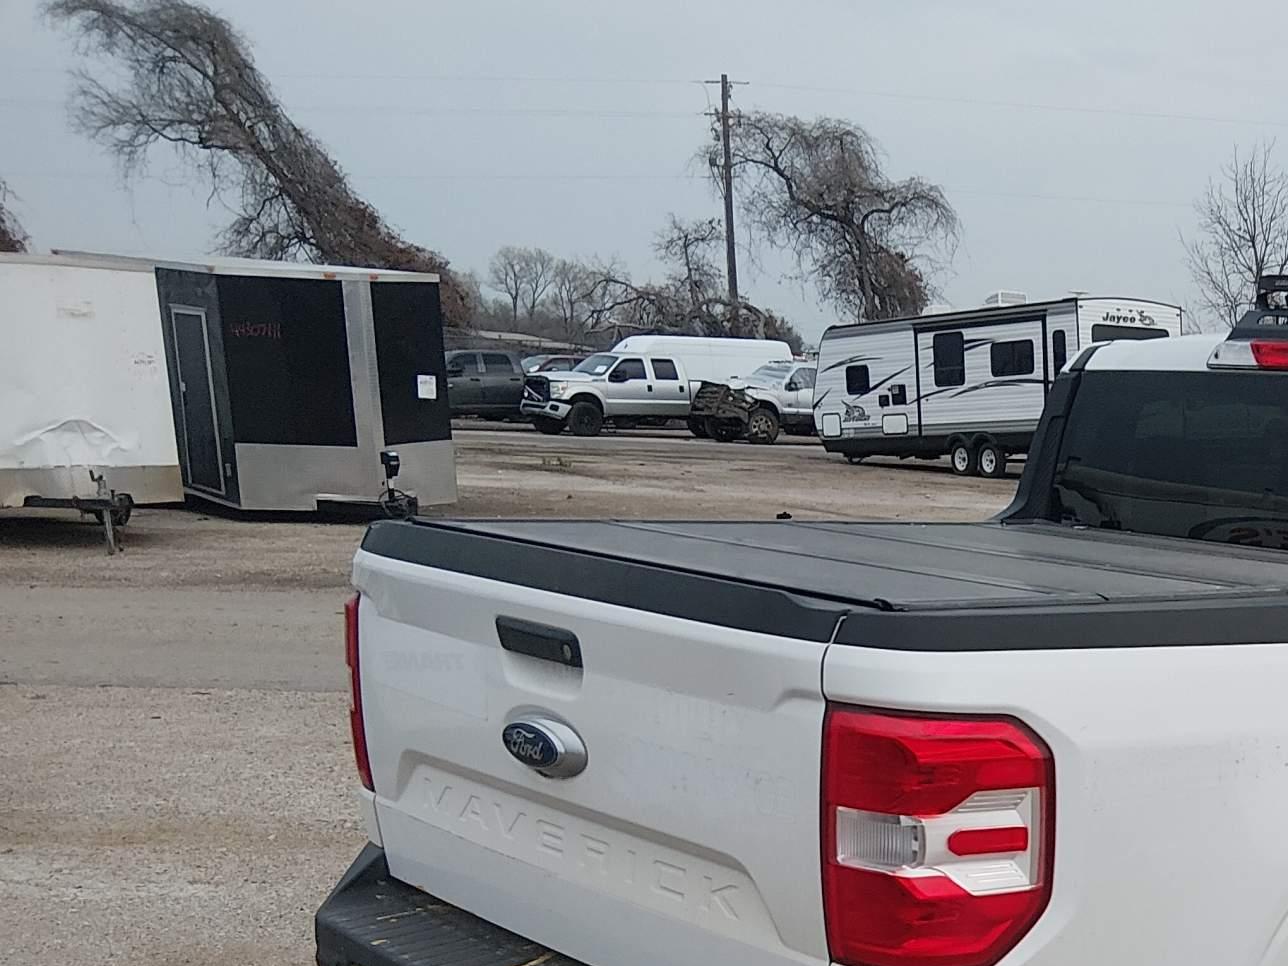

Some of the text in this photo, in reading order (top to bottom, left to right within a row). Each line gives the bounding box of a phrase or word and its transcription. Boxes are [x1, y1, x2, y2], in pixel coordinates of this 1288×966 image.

[1101, 311, 1137, 324] Jayco
[510, 728, 545, 761] Ford
[422, 777, 739, 921] MAVERICK
